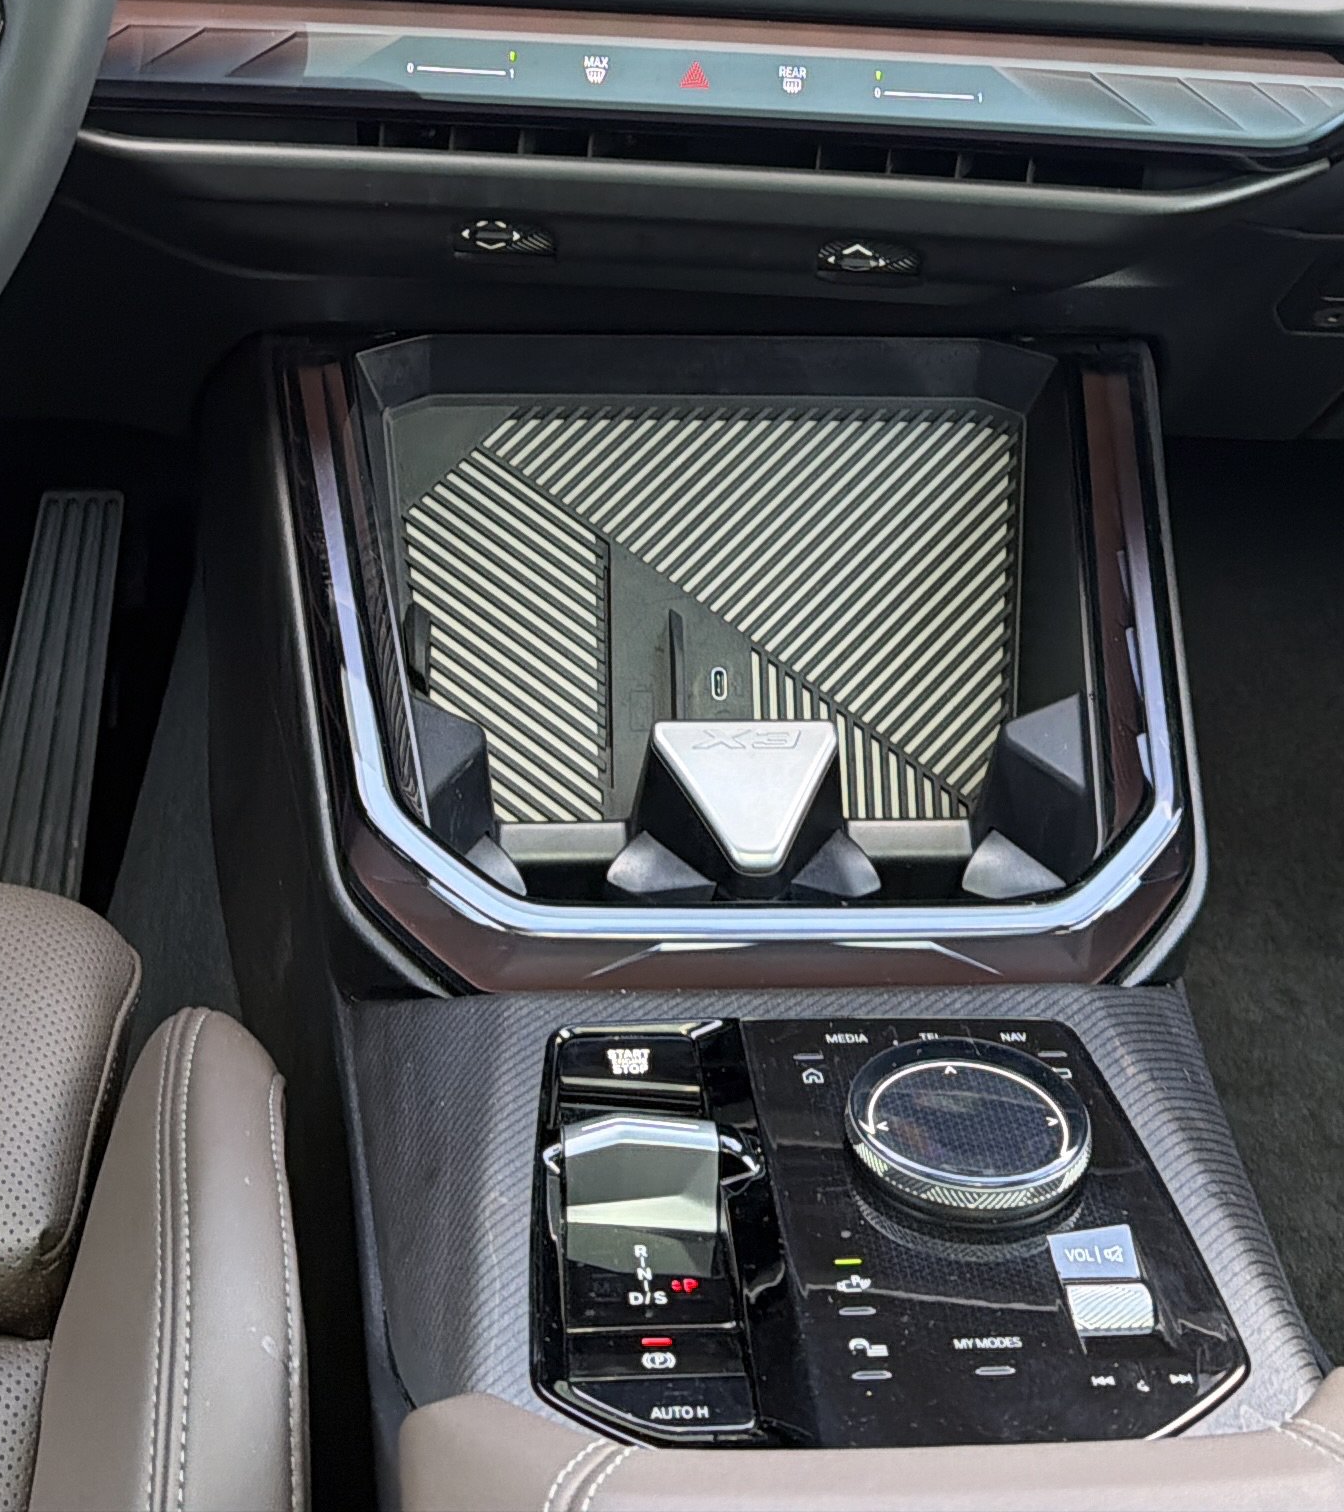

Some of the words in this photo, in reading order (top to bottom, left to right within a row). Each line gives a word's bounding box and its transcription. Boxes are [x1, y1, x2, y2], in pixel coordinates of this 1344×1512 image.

[583, 55, 609, 69] MAX
[778, 65, 807, 79] REAR
[692, 728, 802, 750] X3
[825, 1032, 869, 1045] MEDIA
[1000, 1031, 1027, 1043] NAV
[607, 1048, 651, 1060] START
[612, 1064, 649, 1075] STOP
[633, 1244, 649, 1258] R
[1064, 1247, 1095, 1263] VOL
[637, 1266, 653, 1281] N
[953, 1338, 976, 1350] MY
[976, 1336, 1023, 1350] MODES
[650, 1405, 694, 1420] AUTO
[696, 1405, 710, 1419] H
